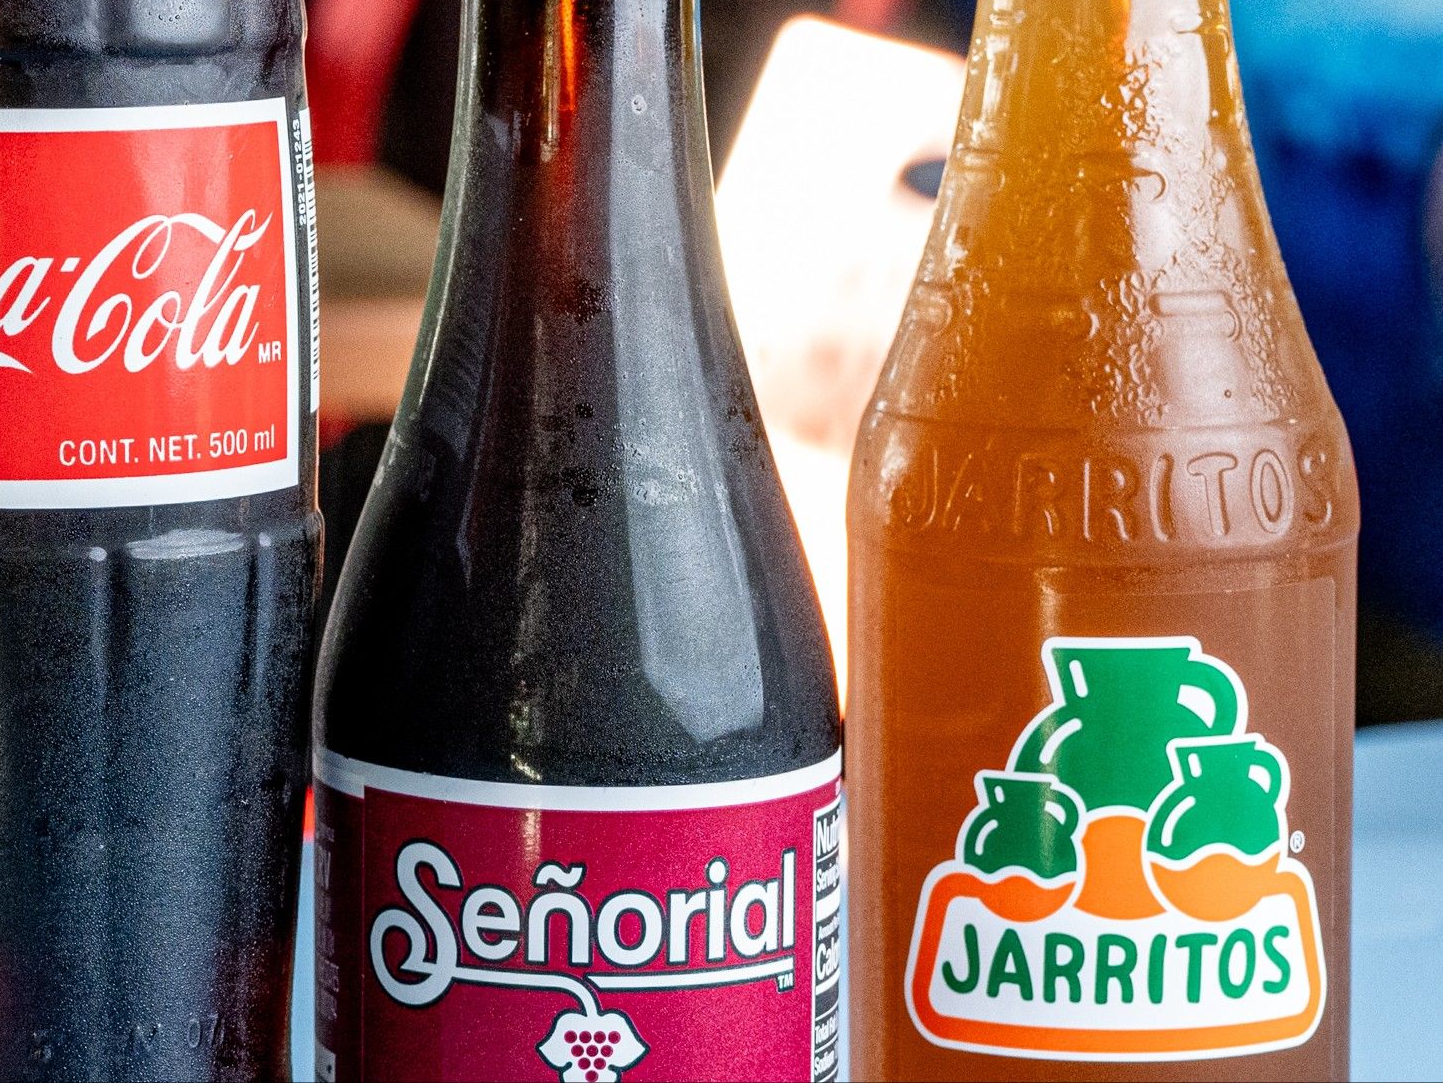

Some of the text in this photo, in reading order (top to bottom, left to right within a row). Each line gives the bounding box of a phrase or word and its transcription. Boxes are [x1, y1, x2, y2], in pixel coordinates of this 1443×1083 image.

[293, 119, 306, 226] 2021-01243
[258, 341, 281, 363] MR
[59, 438, 139, 467] CONT.
[148, 435, 201, 462] NET.
[209, 429, 247, 457] 500
[254, 423, 275, 450] ml
[370, 841, 795, 1006] Señorial
[941, 923, 1292, 1006] JARRITOS
